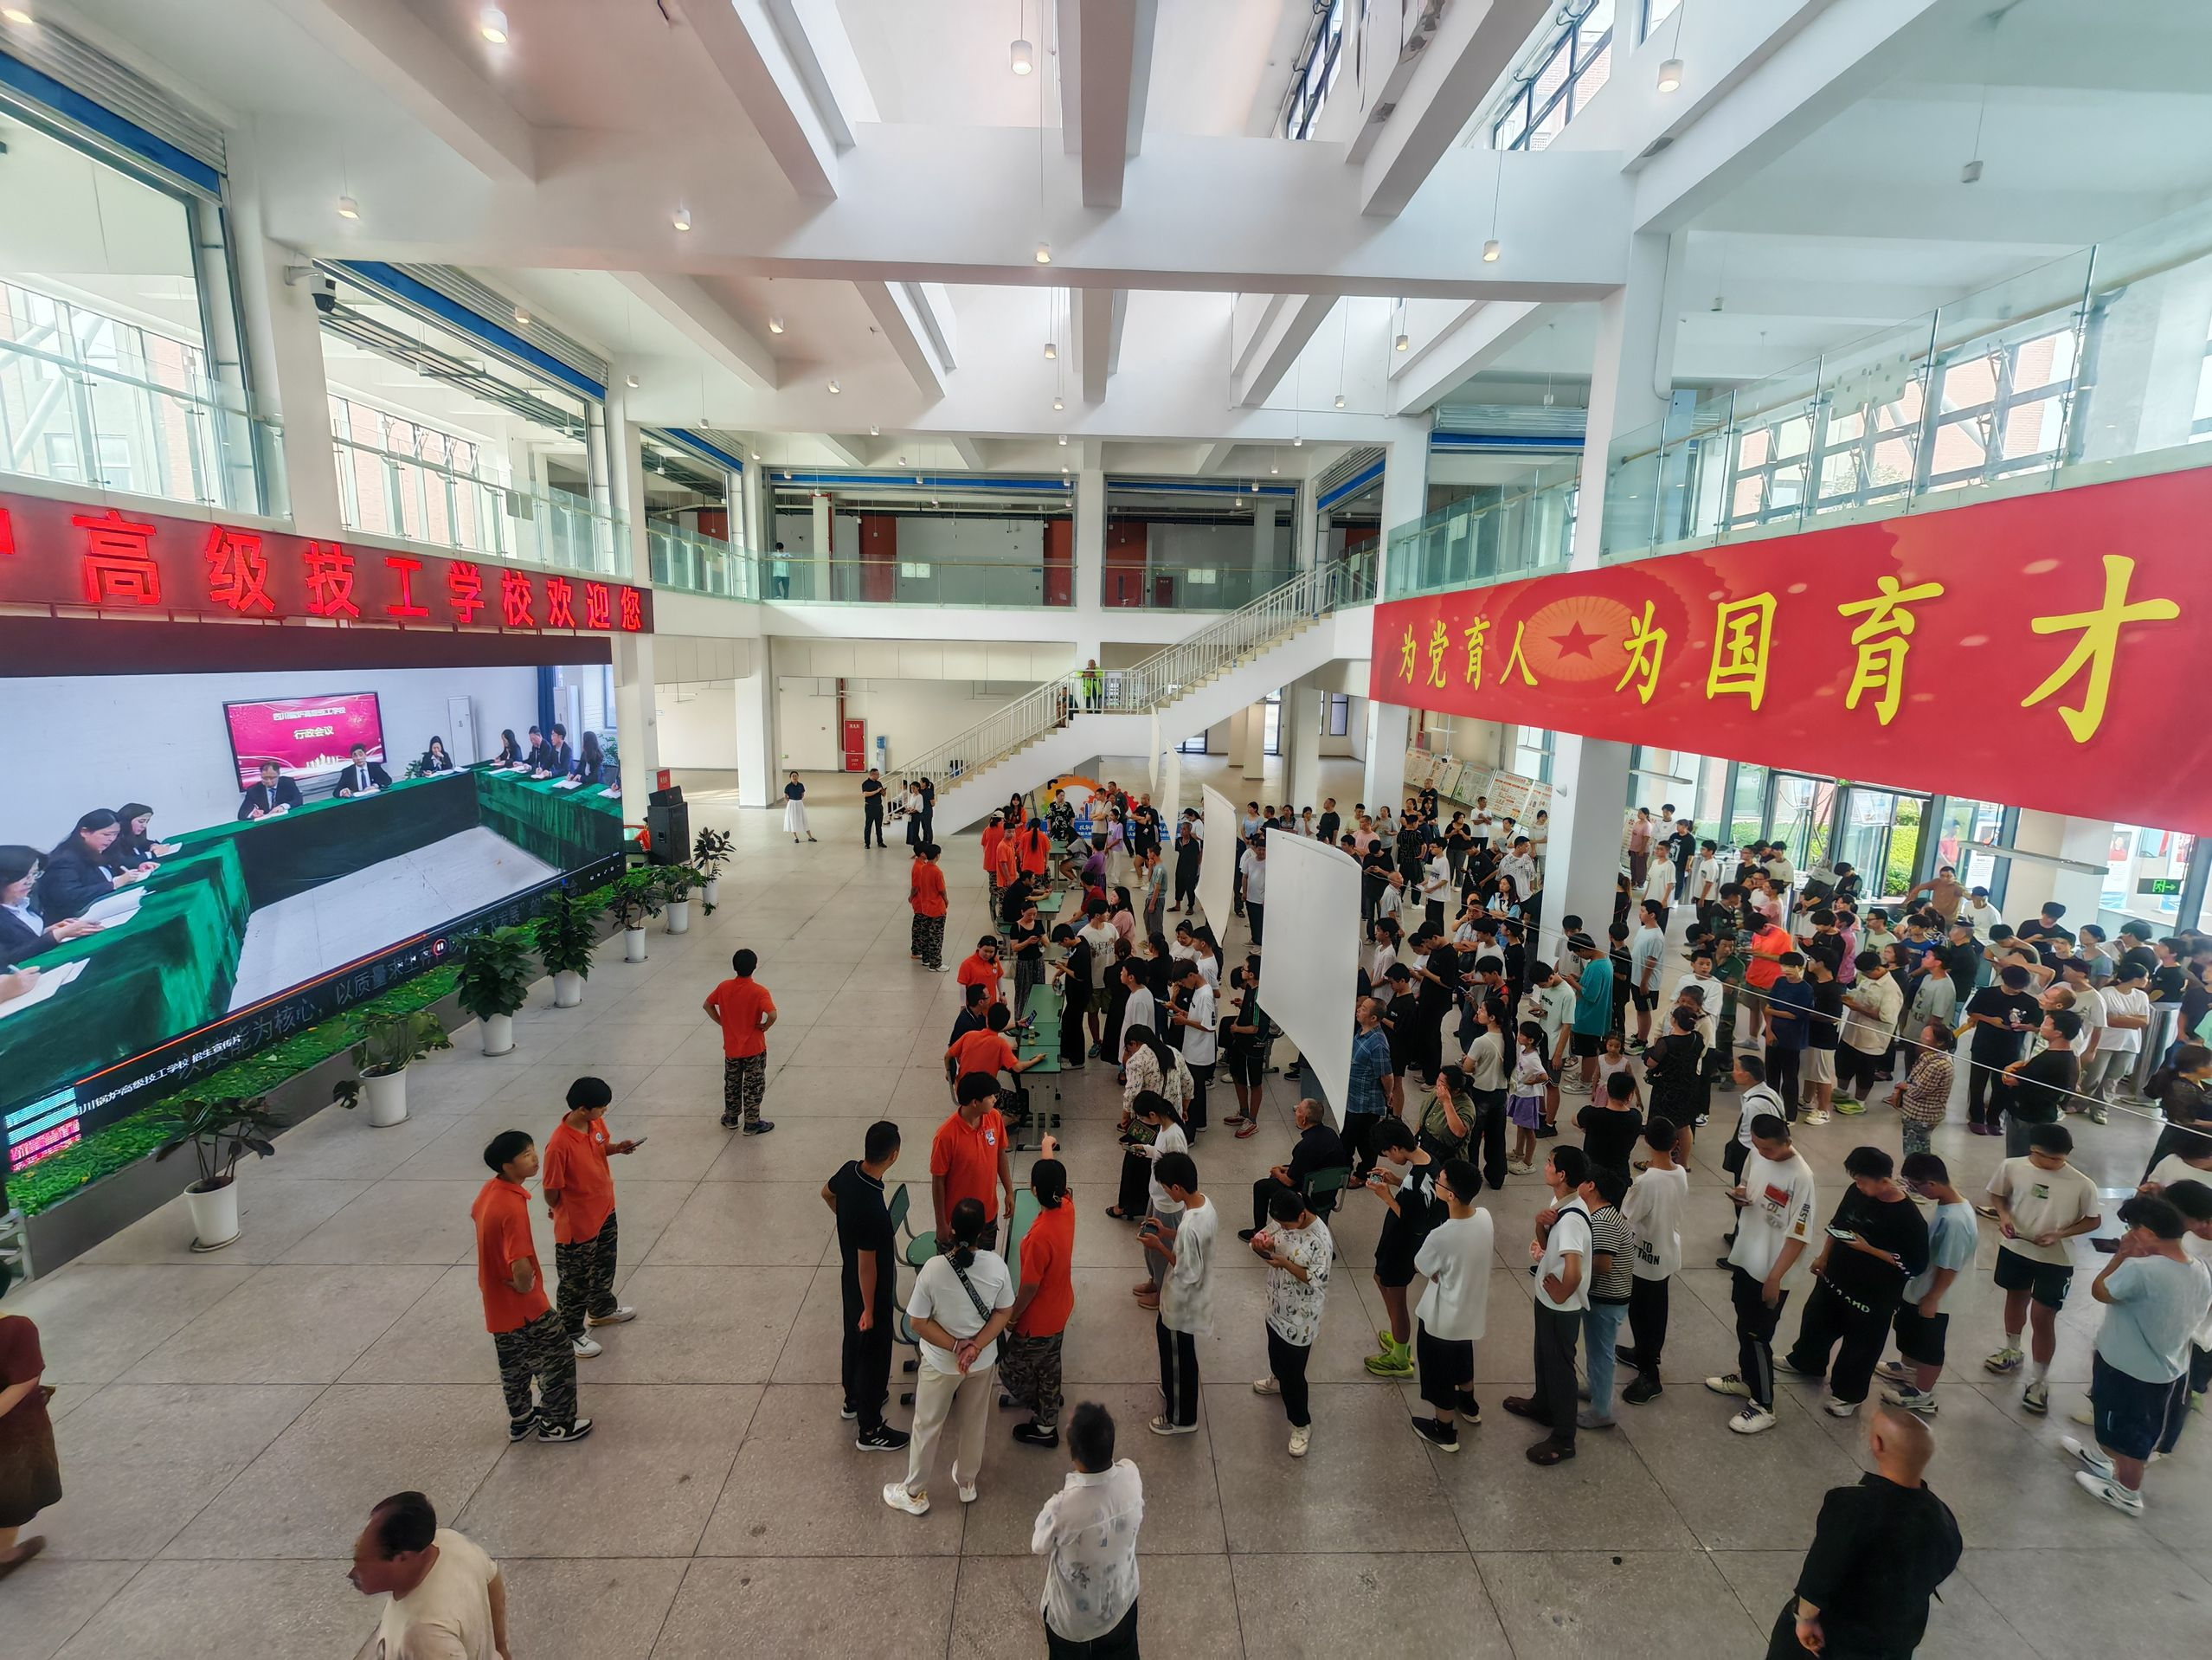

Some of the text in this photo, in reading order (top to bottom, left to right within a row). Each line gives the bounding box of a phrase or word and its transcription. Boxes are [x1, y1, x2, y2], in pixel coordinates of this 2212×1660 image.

[0, 508, 641, 630] 高级技工学校欢迎您
[1399, 554, 2180, 743] 为党育人 为国育才
[1634, 1245, 1660, 1265] TRON
